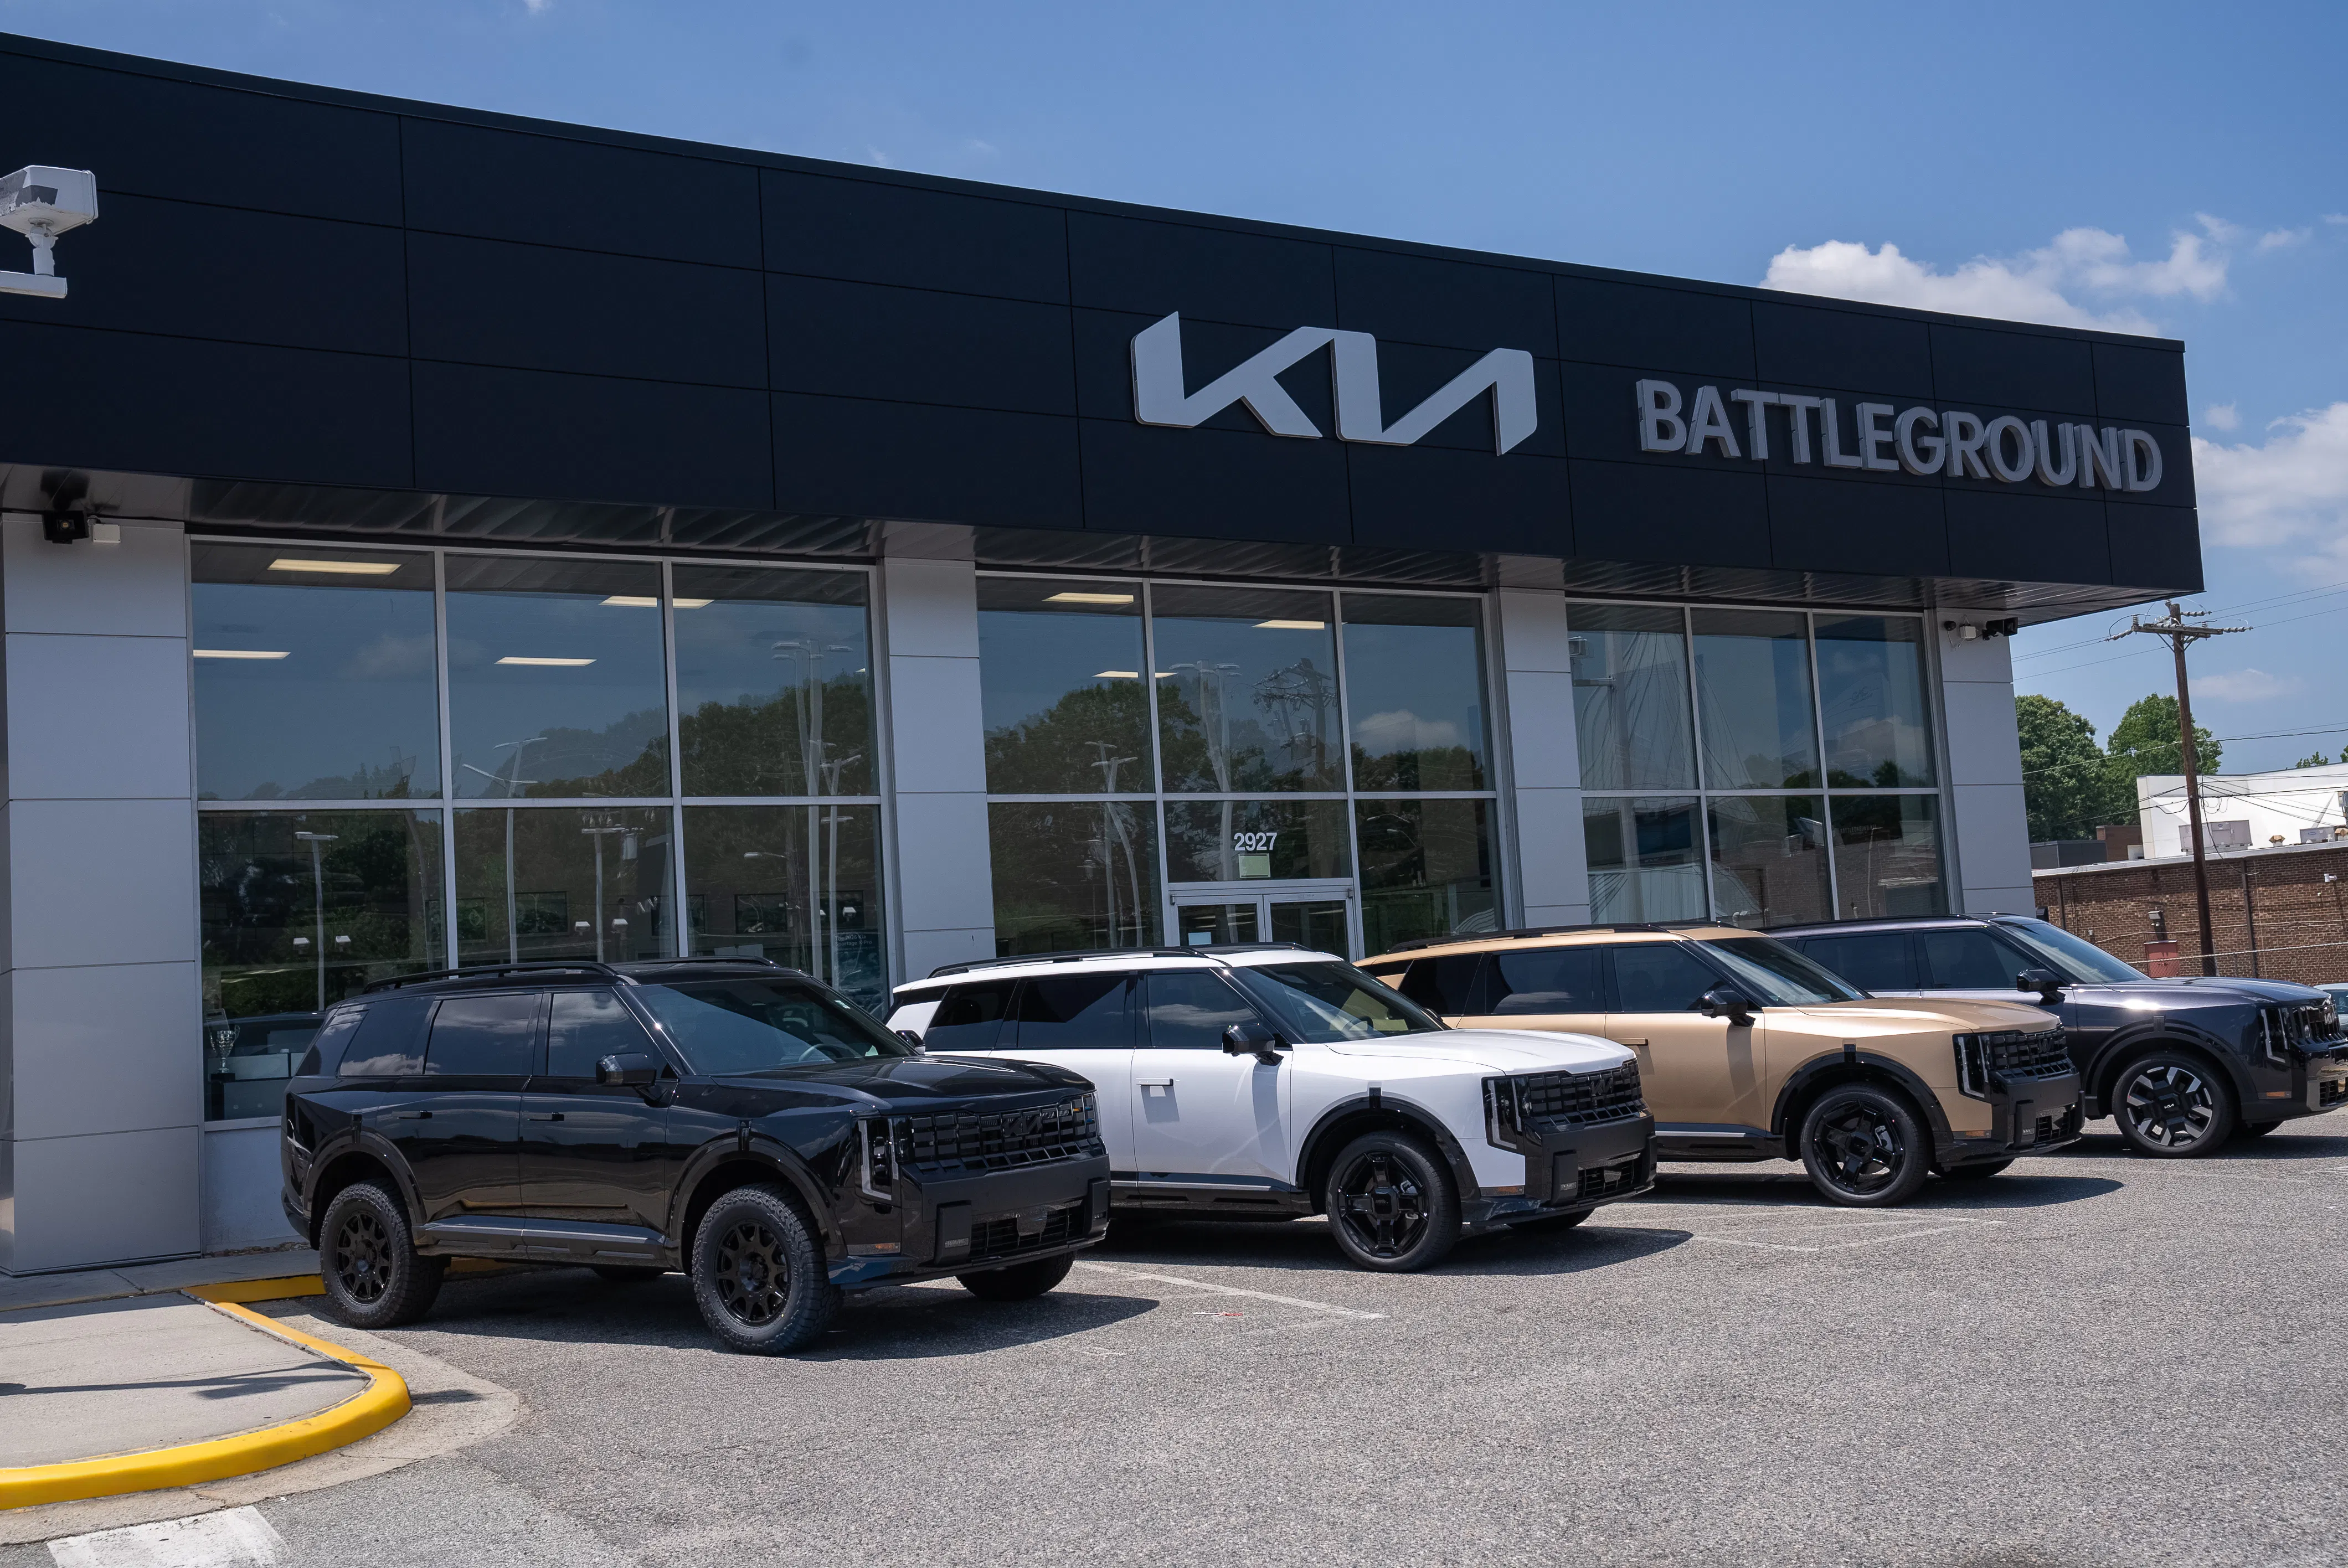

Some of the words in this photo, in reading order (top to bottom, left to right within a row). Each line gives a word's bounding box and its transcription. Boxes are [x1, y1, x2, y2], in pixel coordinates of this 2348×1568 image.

[1130, 311, 1538, 456] KIA
[1636, 379, 2162, 492] BATTLEGROUND
[1234, 832, 1277, 851] 2927
